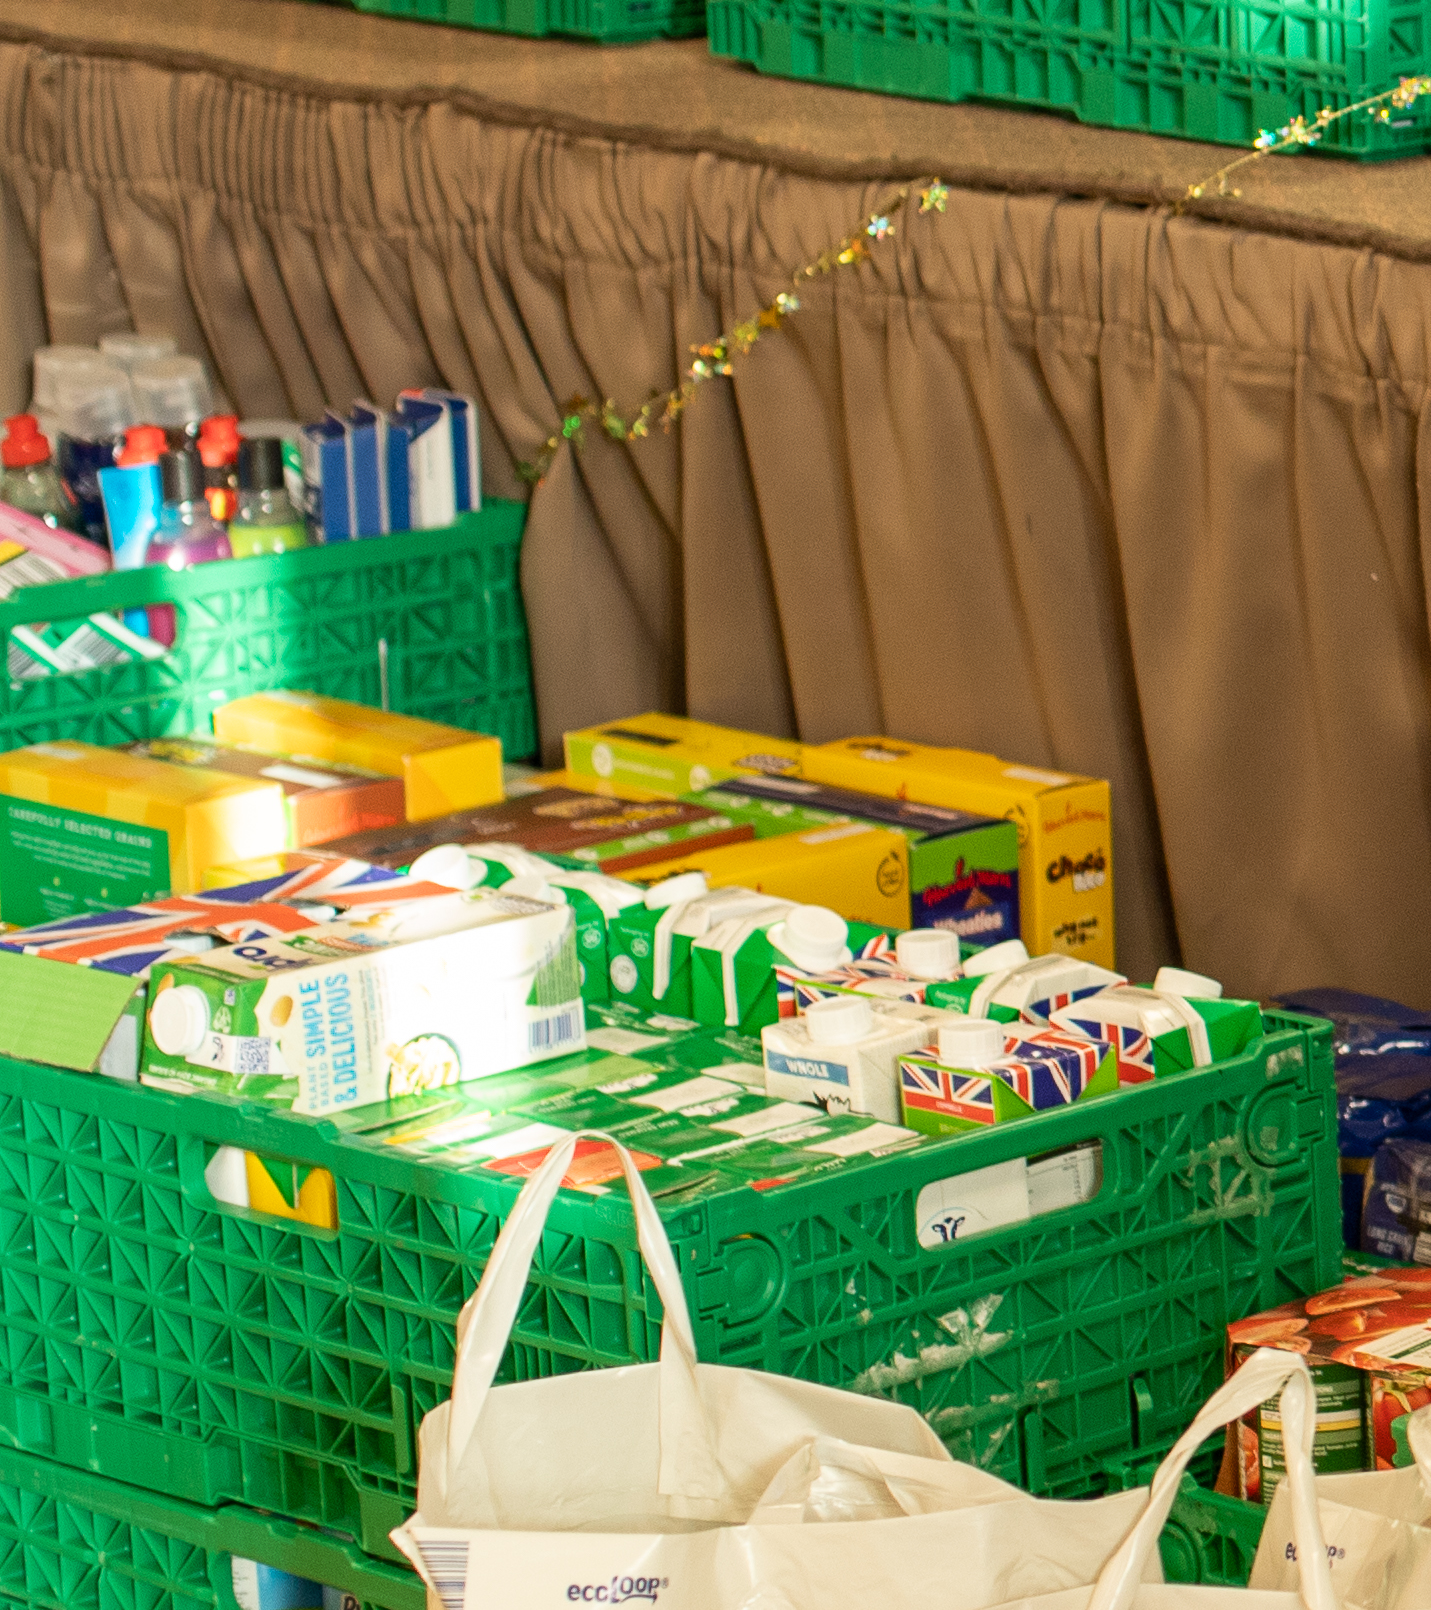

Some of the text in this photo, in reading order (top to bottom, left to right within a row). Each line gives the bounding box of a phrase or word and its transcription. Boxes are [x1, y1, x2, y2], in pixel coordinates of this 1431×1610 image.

[299, 978, 328, 1059] SIMPLE
[324, 972, 359, 1104] & DELICIOUS
